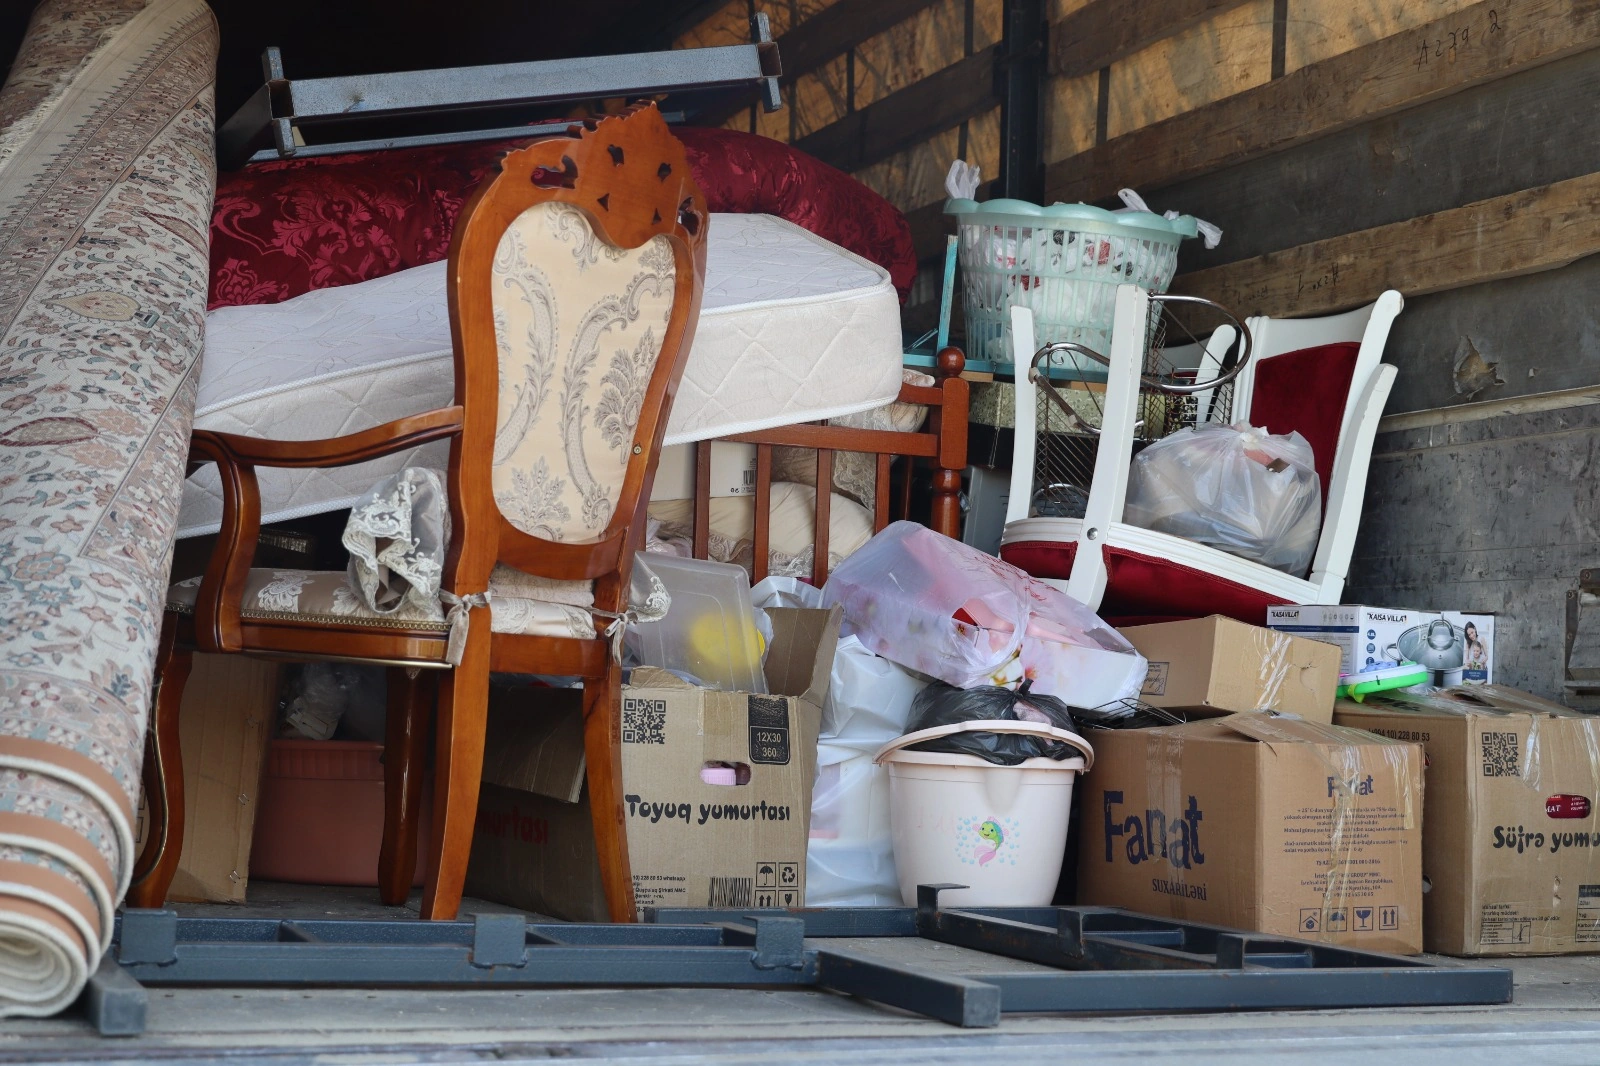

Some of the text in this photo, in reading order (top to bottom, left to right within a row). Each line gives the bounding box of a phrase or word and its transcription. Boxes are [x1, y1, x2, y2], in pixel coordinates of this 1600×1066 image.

[756, 731, 782, 743] 12X30
[1397, 731, 1410, 740] 228
[1411, 731, 1420, 741] 80
[1421, 732, 1430, 742] 53
[762, 747, 777, 758] 360
[1327, 774, 1374, 798] Fat
[624, 794, 790, 826] Toyuq yumurtası
[1104, 789, 1205, 870] Fanat
[1492, 825, 1545, 854] Süfrə
